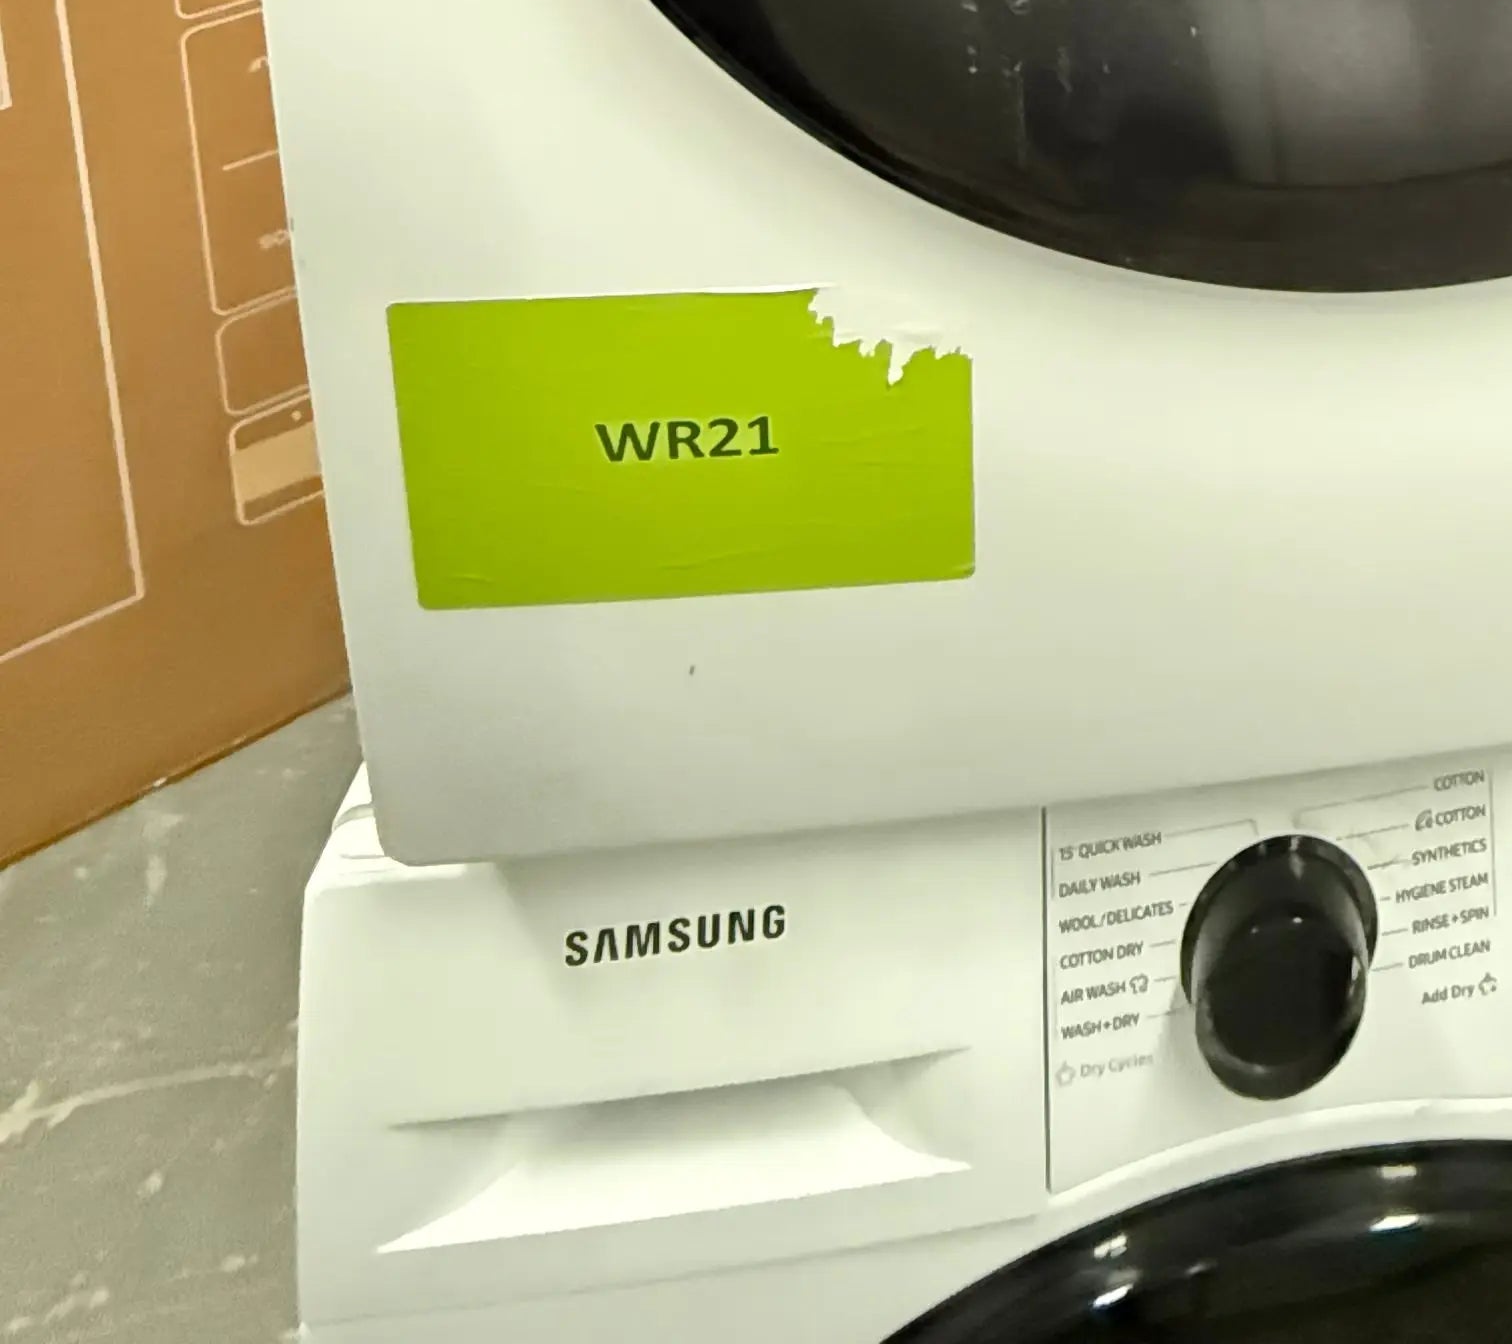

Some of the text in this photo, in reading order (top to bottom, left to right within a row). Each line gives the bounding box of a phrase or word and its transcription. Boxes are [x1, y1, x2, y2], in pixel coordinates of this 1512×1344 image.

[594, 415, 780, 463] WR21
[1433, 769, 1485, 792] COTTON
[1435, 804, 1486, 826] COTTON
[1078, 839, 1121, 860] QUICK
[1122, 832, 1162, 851] WASH
[1411, 838, 1487, 866] SYNTHETICS
[1058, 870, 1141, 898] DAILY WASH
[1395, 872, 1489, 904] HYGIENE STEAM
[1412, 913, 1450, 935] RINSE
[1460, 905, 1489, 924] SPIN
[564, 904, 786, 967] SAMSUNG
[1060, 940, 1144, 970] COTTON DRY
[1408, 939, 1491, 969] DRUM CLEAN
[1060, 980, 1126, 1005] AIR WASH
[1421, 985, 1475, 1005] Add Dry
[1080, 1062, 1106, 1079] Dry
